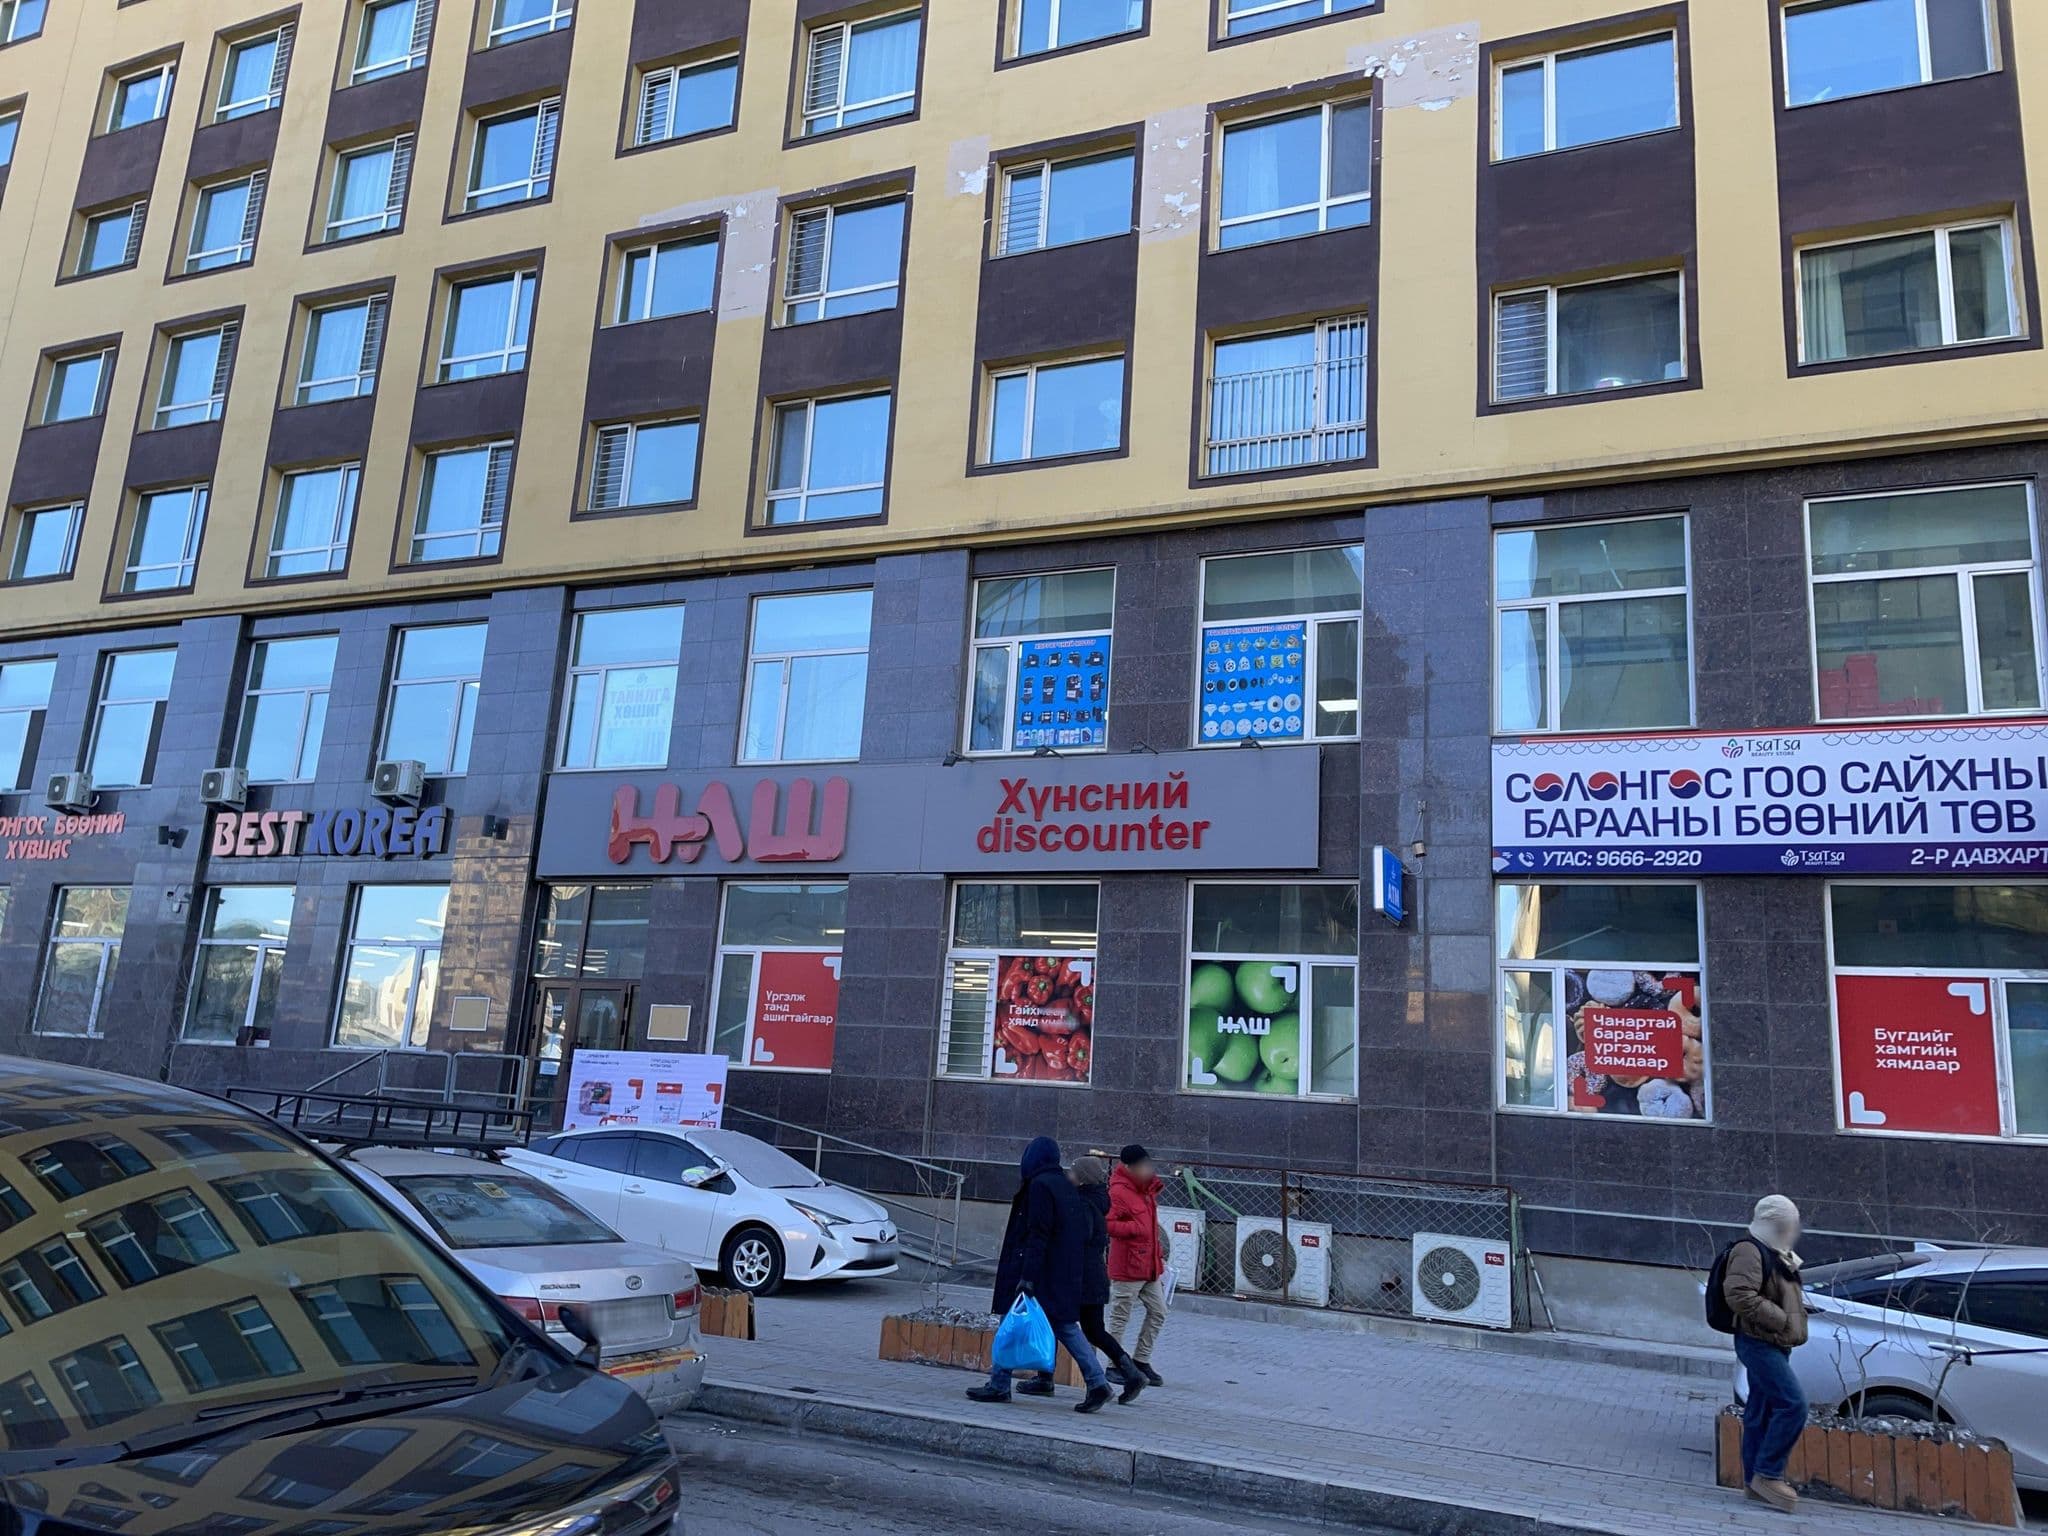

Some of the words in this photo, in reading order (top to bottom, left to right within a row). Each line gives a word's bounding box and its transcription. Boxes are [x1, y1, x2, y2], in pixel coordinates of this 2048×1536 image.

[1744, 738, 1801, 752] TsaTsa
[1743, 765, 1827, 798] ГОО
[1840, 754, 2048, 794] САЙХНЫ
[997, 771, 1189, 822] Хүнсний
[54, 811, 126, 836] БӨӨНИЙ
[607, 775, 850, 864] НАШ
[1524, 805, 1721, 839] БАРААНЫ
[1734, 796, 1929, 837] БӨӨНИЙ
[1940, 800, 2037, 834] ТӨВ
[211, 811, 305, 857] BEST
[303, 806, 448, 860] KOREA
[976, 814, 1211, 853] discounter
[5, 840, 72, 860] ХУВЦАС
[1799, 850, 1845, 862] TsaTsa
[1911, 848, 1949, 865] 2-Р
[1952, 847, 2048, 867] ДАВХАРТ
[1543, 851, 1592, 867] УТАС:
[1596, 851, 1702, 867] 9666-2920
[766, 990, 806, 1003] Үргэлж
[764, 1003, 790, 1012] танд
[763, 1013, 834, 1026] ашигтайгаар
[1008, 1018, 1039, 1028] хямд
[1217, 1016, 1271, 1035] НАШ
[1593, 1014, 1677, 1030] Чанартай
[1593, 1027, 1654, 1042] барааг
[1874, 1028, 1954, 1043] Бүгдийг
[1594, 1043, 1657, 1054] үргэлж
[1875, 1043, 1958, 1057] хамгийн
[1594, 1056, 1669, 1071] хямдаар
[1876, 1058, 1960, 1074] хямдаар
[1487, 1255, 1503, 1263] TCL
